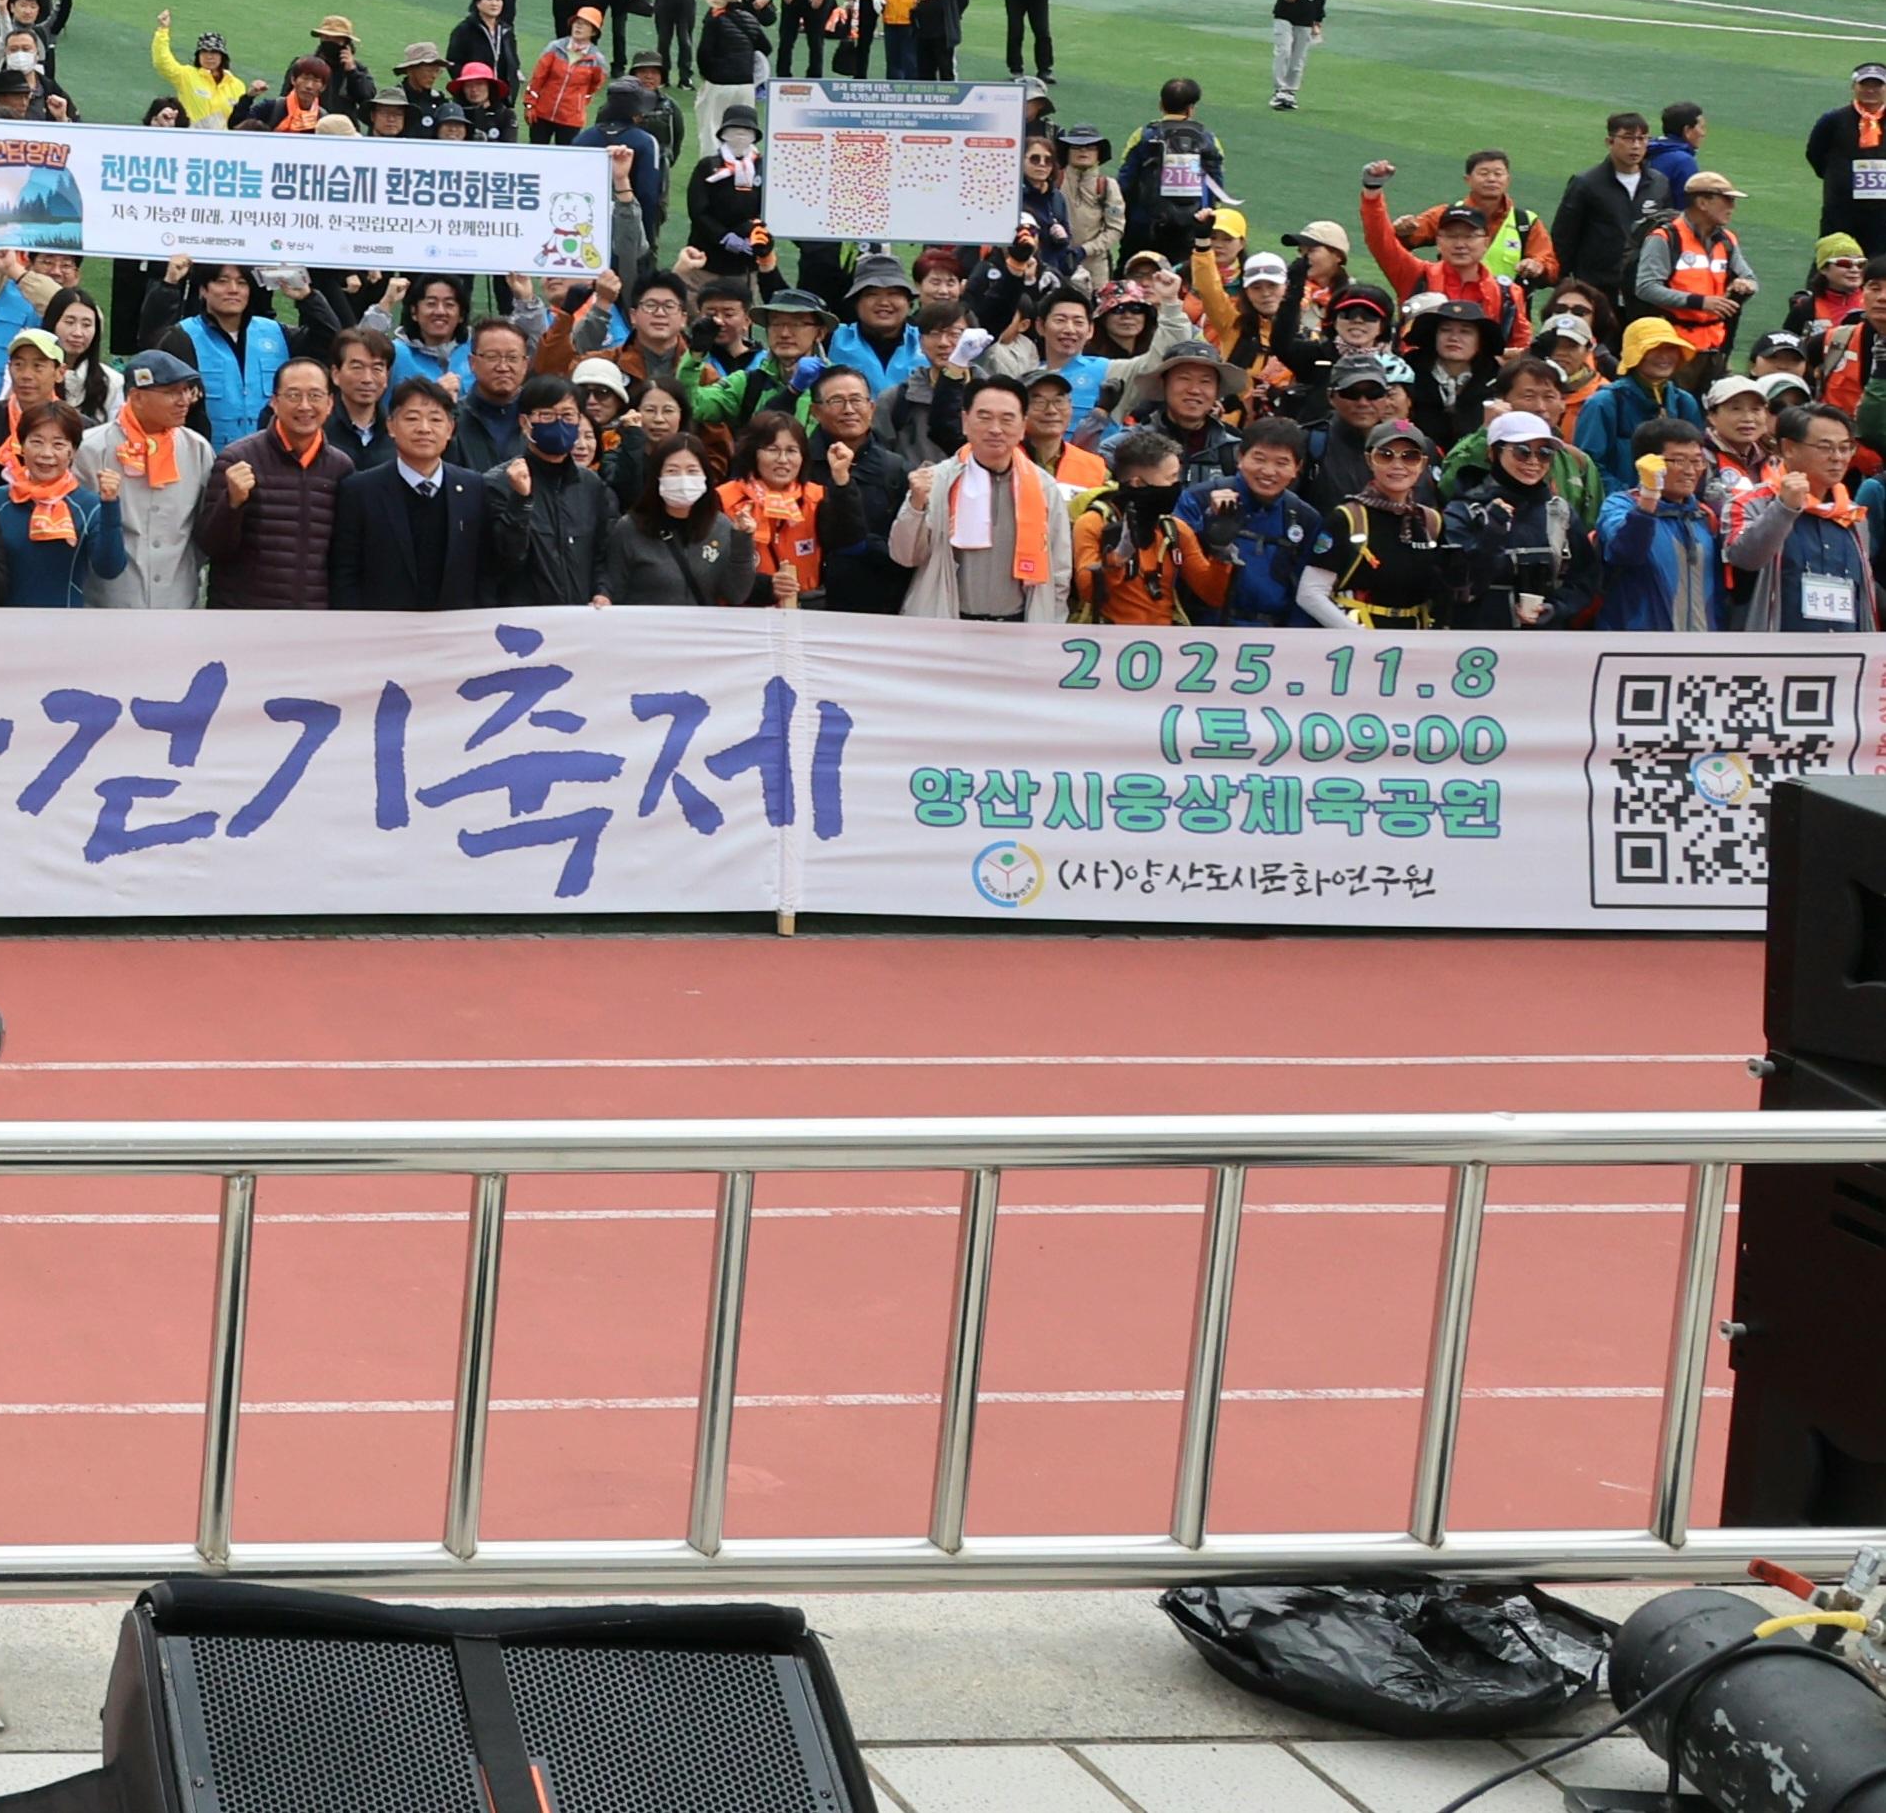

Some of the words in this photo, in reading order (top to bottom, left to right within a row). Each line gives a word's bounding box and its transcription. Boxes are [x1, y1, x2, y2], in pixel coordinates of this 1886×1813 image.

[101, 154, 178, 195] 천성산
[185, 158, 263, 199] 화엄늪
[271, 162, 377, 205] 생태습지
[386, 167, 541, 211] 환경정화활동
[111, 203, 139, 221] 지속
[143, 205, 186, 225] 가능한
[229, 209, 286, 228] 지역사회
[328, 215, 442, 236] 한국필립모리스가
[447, 219, 524, 238] 함께합니다.
[1060, 637, 1500, 698] 2025.11.8
[1160, 703, 1508, 766] (토)09:00
[909, 765, 1503, 840] 양산시웅상체육공원
[1058, 857, 1436, 898] (사)양산도시문화연구원
